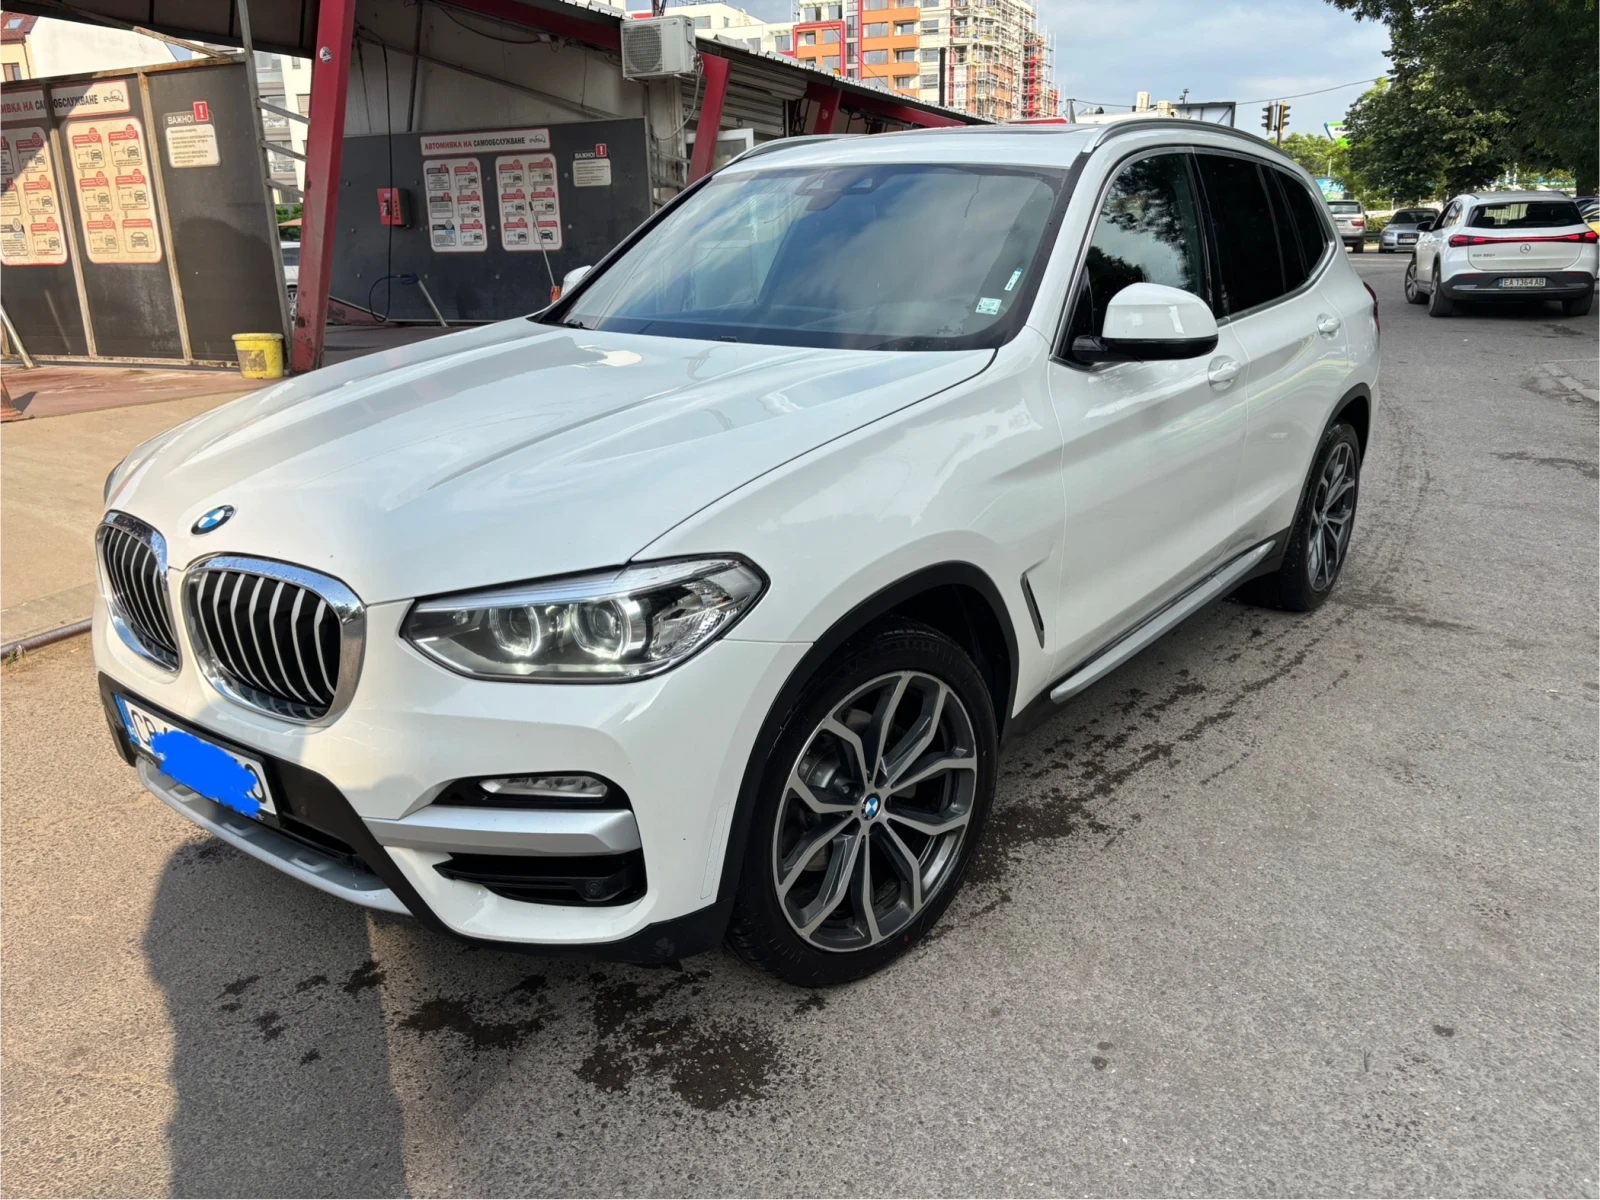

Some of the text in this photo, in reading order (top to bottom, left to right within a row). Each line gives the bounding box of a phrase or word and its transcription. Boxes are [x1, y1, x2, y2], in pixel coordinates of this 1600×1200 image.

[23, 101, 34, 111] НА
[424, 142, 462, 151] АВТОМИВКА
[463, 141, 473, 149] НА
[473, 137, 526, 147] САМООБСЛУЖВАНЕ
